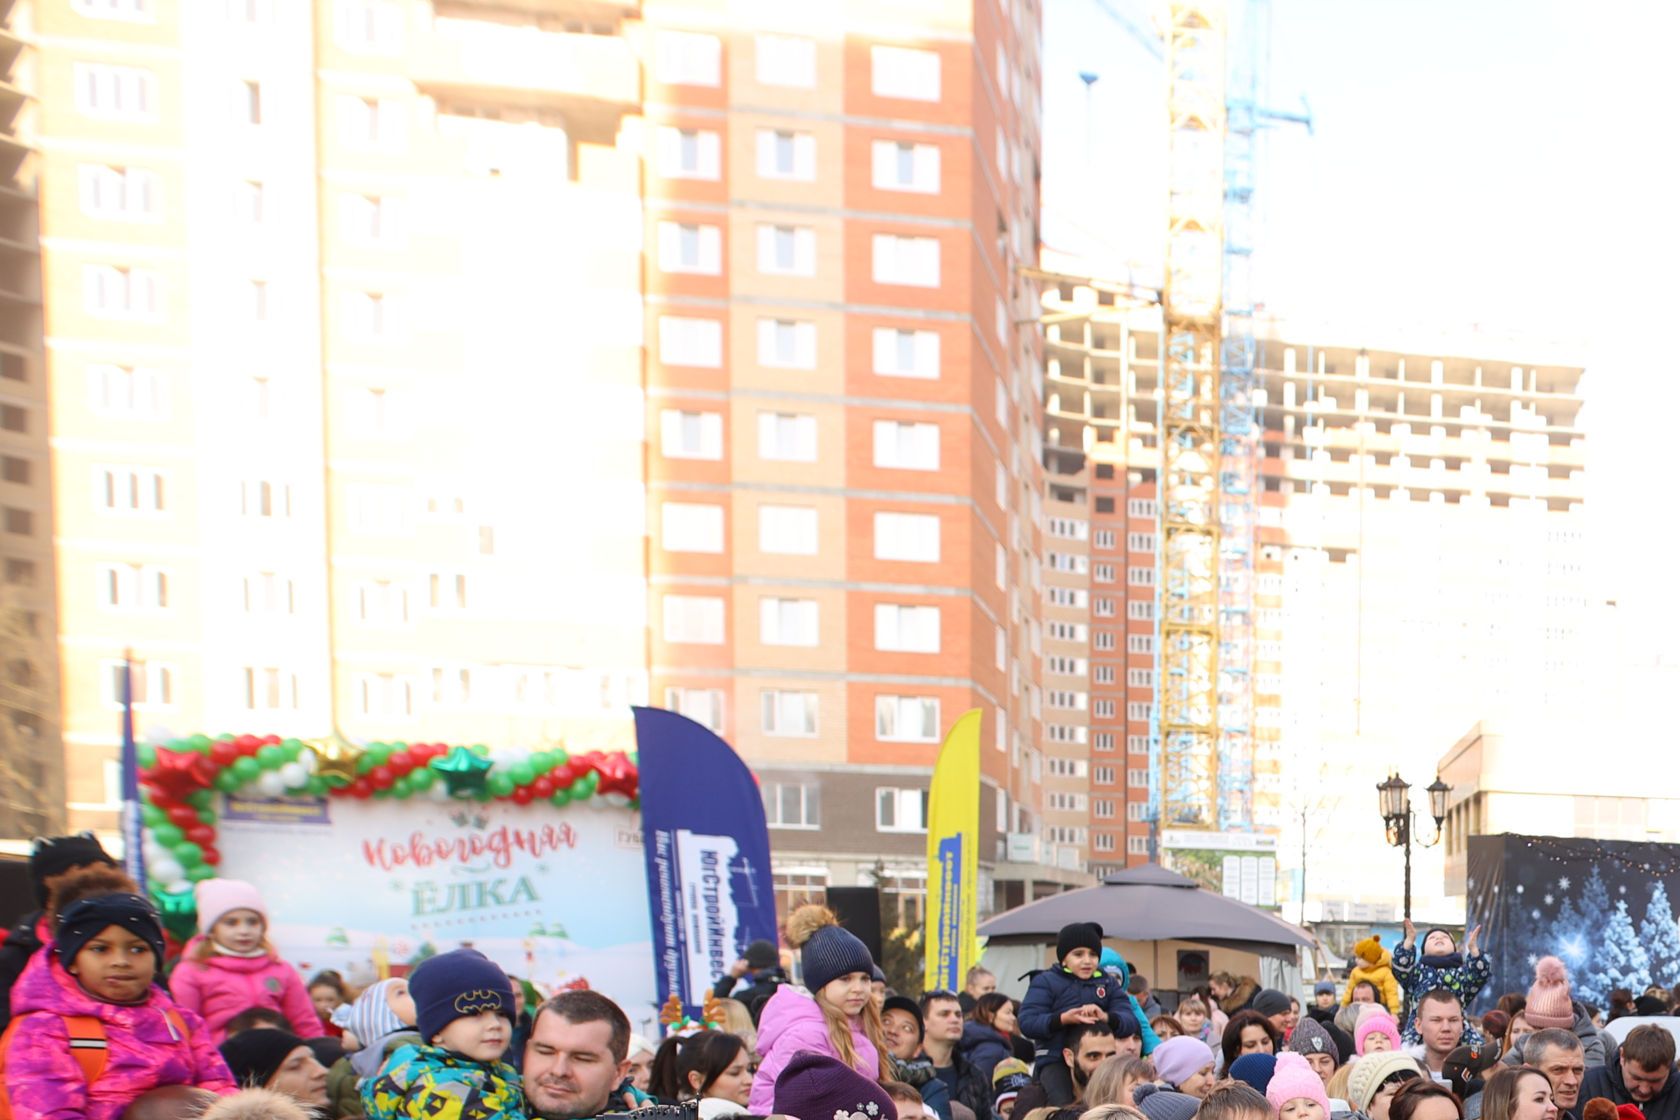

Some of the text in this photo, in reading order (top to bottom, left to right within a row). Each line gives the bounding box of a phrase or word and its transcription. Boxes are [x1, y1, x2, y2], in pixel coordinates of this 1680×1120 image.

[361, 822, 577, 871] Новогодняя
[411, 876, 540, 917] ЁЛКА
[701, 850, 725, 983] ЮгСтройИнвес
